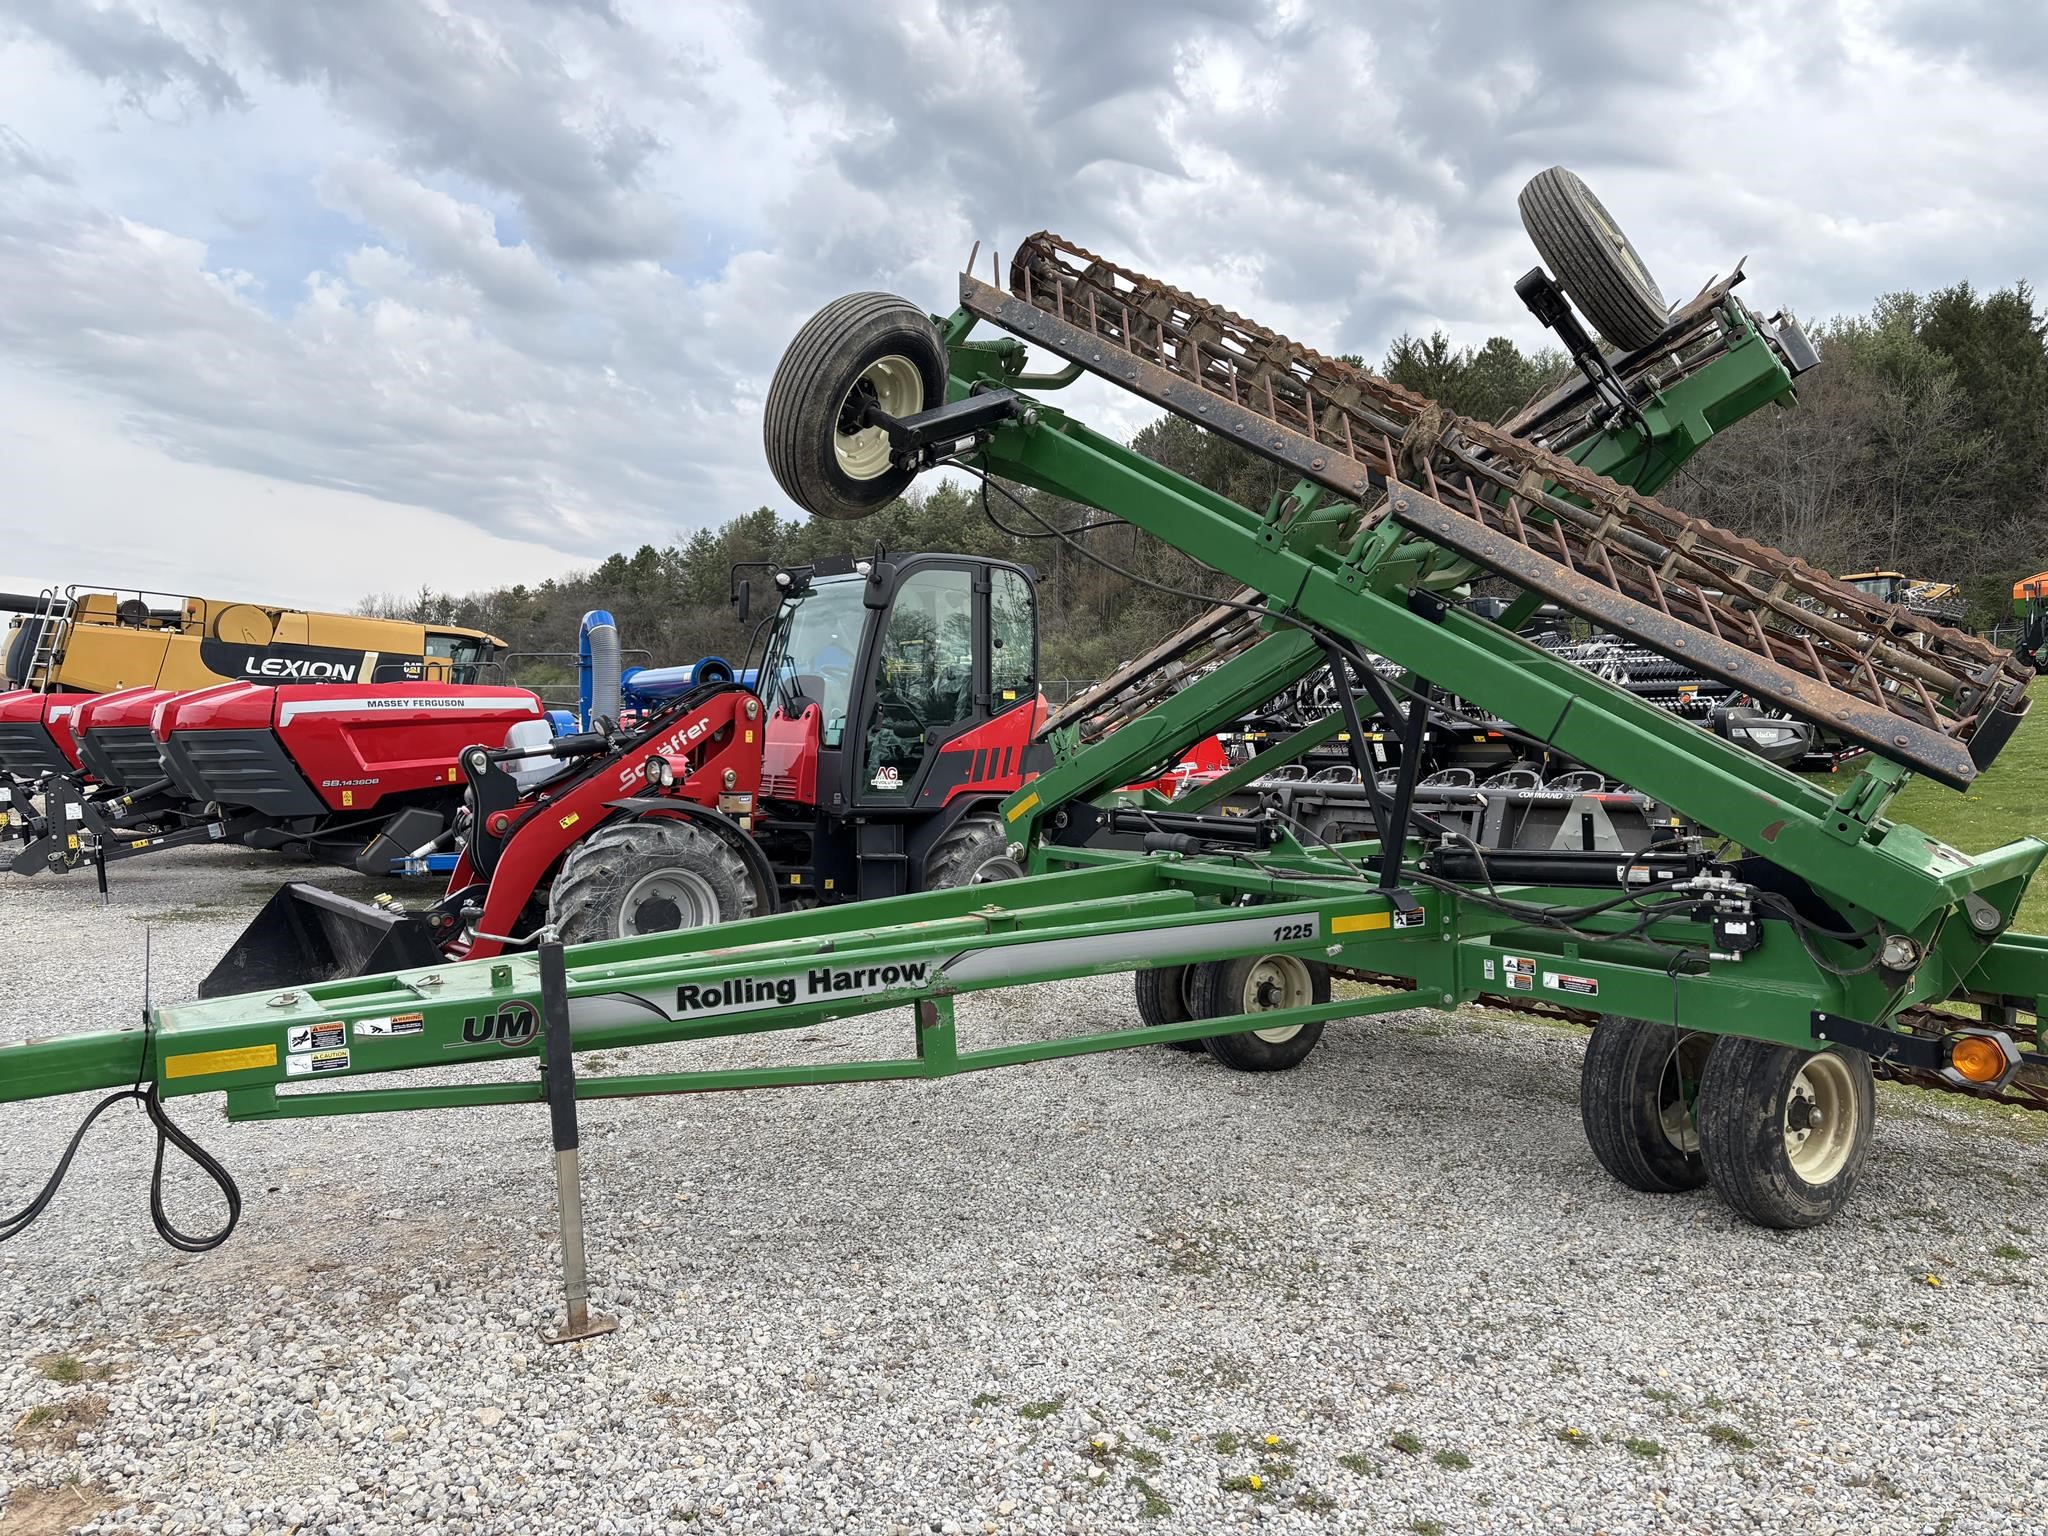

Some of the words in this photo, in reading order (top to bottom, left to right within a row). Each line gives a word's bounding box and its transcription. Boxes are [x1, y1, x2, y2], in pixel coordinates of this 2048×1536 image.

[245, 656, 355, 681] LEXION
[403, 662, 422, 673] CAT
[367, 700, 409, 708] MASSEY
[413, 699, 465, 707] FERGUSON
[618, 717, 710, 792] Scäffer
[877, 767, 897, 780] AG
[1518, 791, 1563, 799] COMMAND
[1273, 923, 1313, 942] 1225
[676, 977, 796, 1012] Rolling
[807, 962, 927, 995] Harrow
[462, 1009, 534, 1043] UM
[319, 1051, 347, 1059] CAUTION
